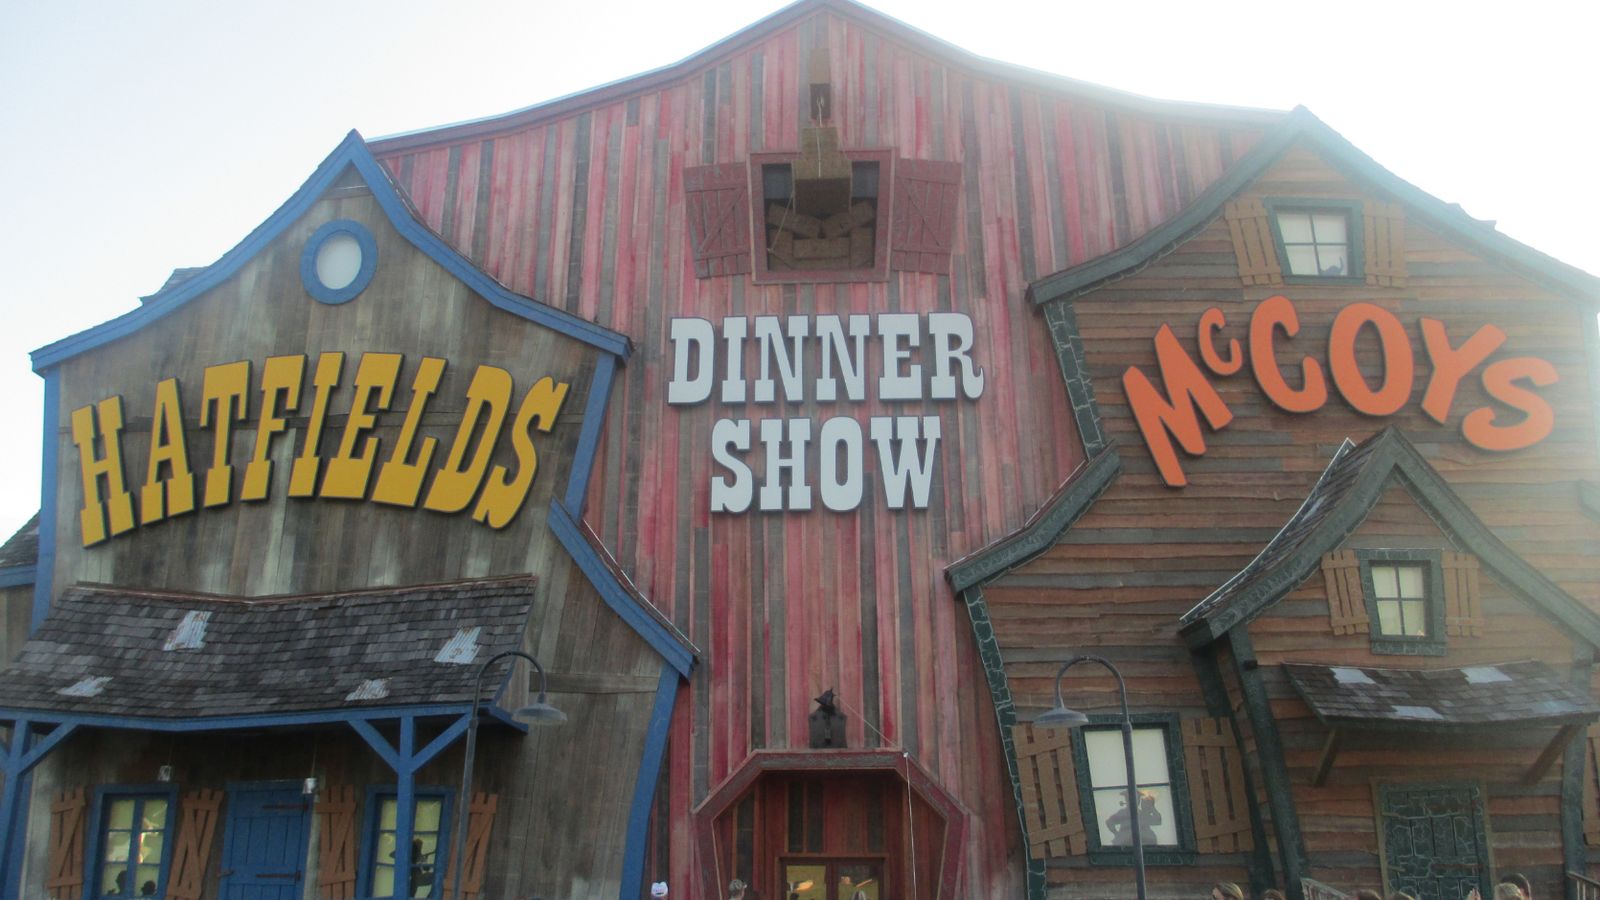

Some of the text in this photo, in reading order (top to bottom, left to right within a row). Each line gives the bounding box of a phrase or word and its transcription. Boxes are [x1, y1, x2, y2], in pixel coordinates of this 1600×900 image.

[668, 312, 984, 404] DINNER
[71, 352, 570, 548] HATFIELDS
[710, 415, 941, 513] SHOW
